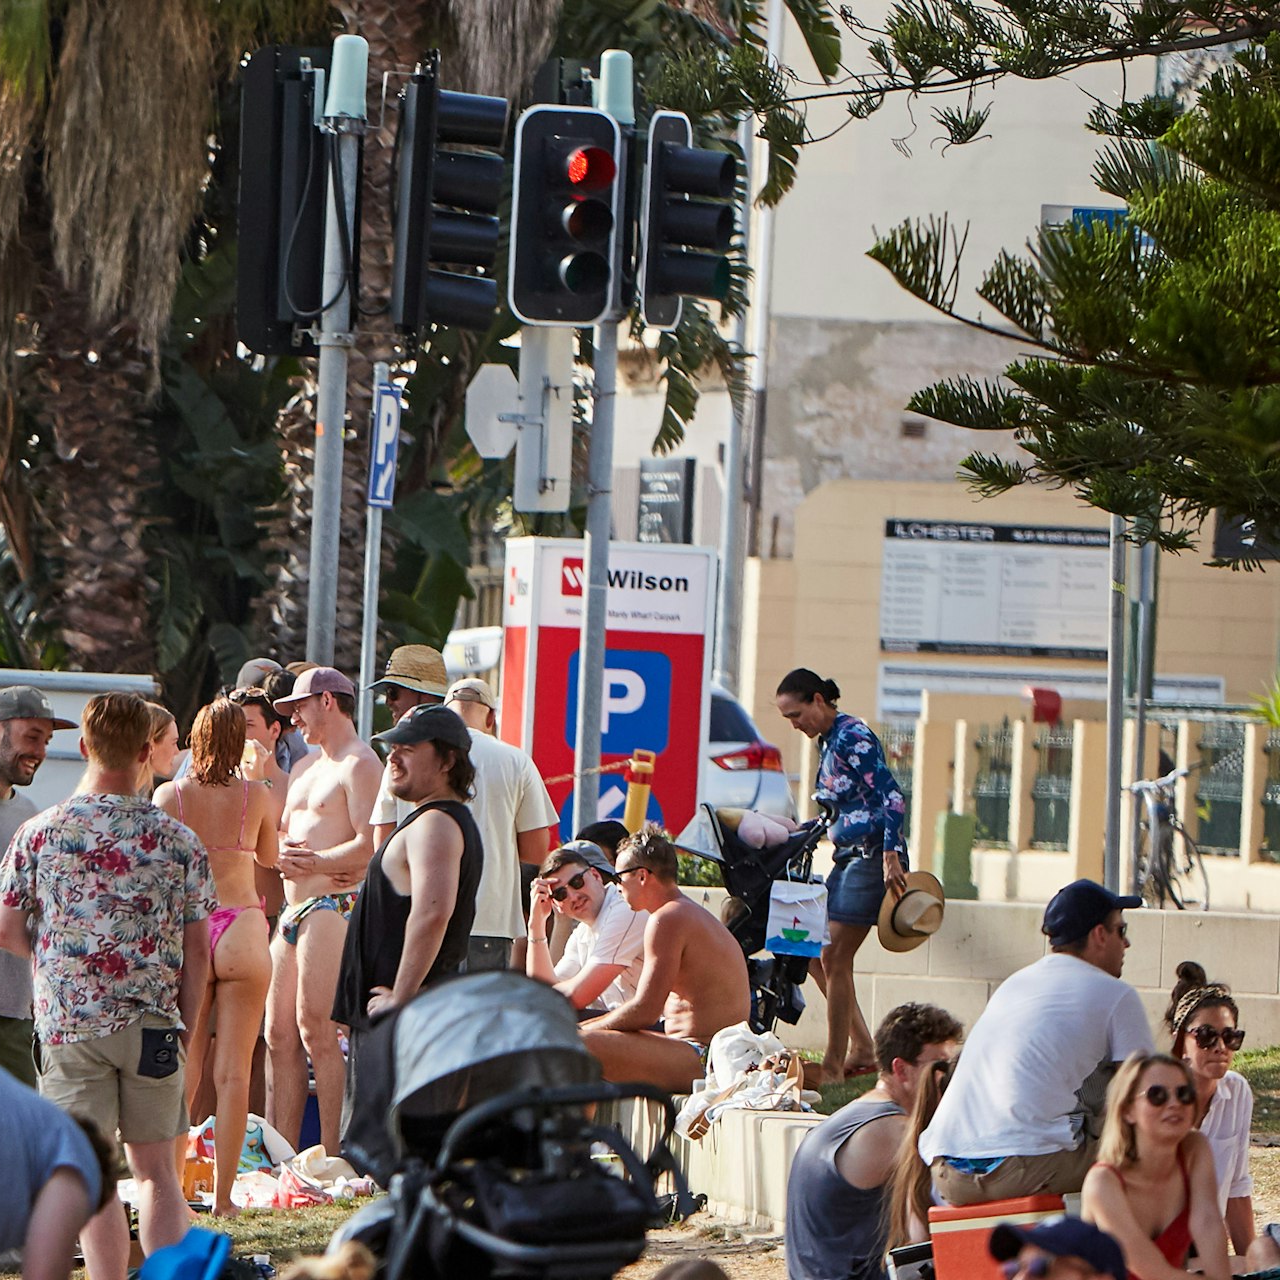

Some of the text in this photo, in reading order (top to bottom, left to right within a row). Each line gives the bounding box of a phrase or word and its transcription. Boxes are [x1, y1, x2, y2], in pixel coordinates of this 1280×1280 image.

[377, 395, 398, 464] P
[608, 569, 689, 592] Wilson
[600, 668, 646, 734] P
